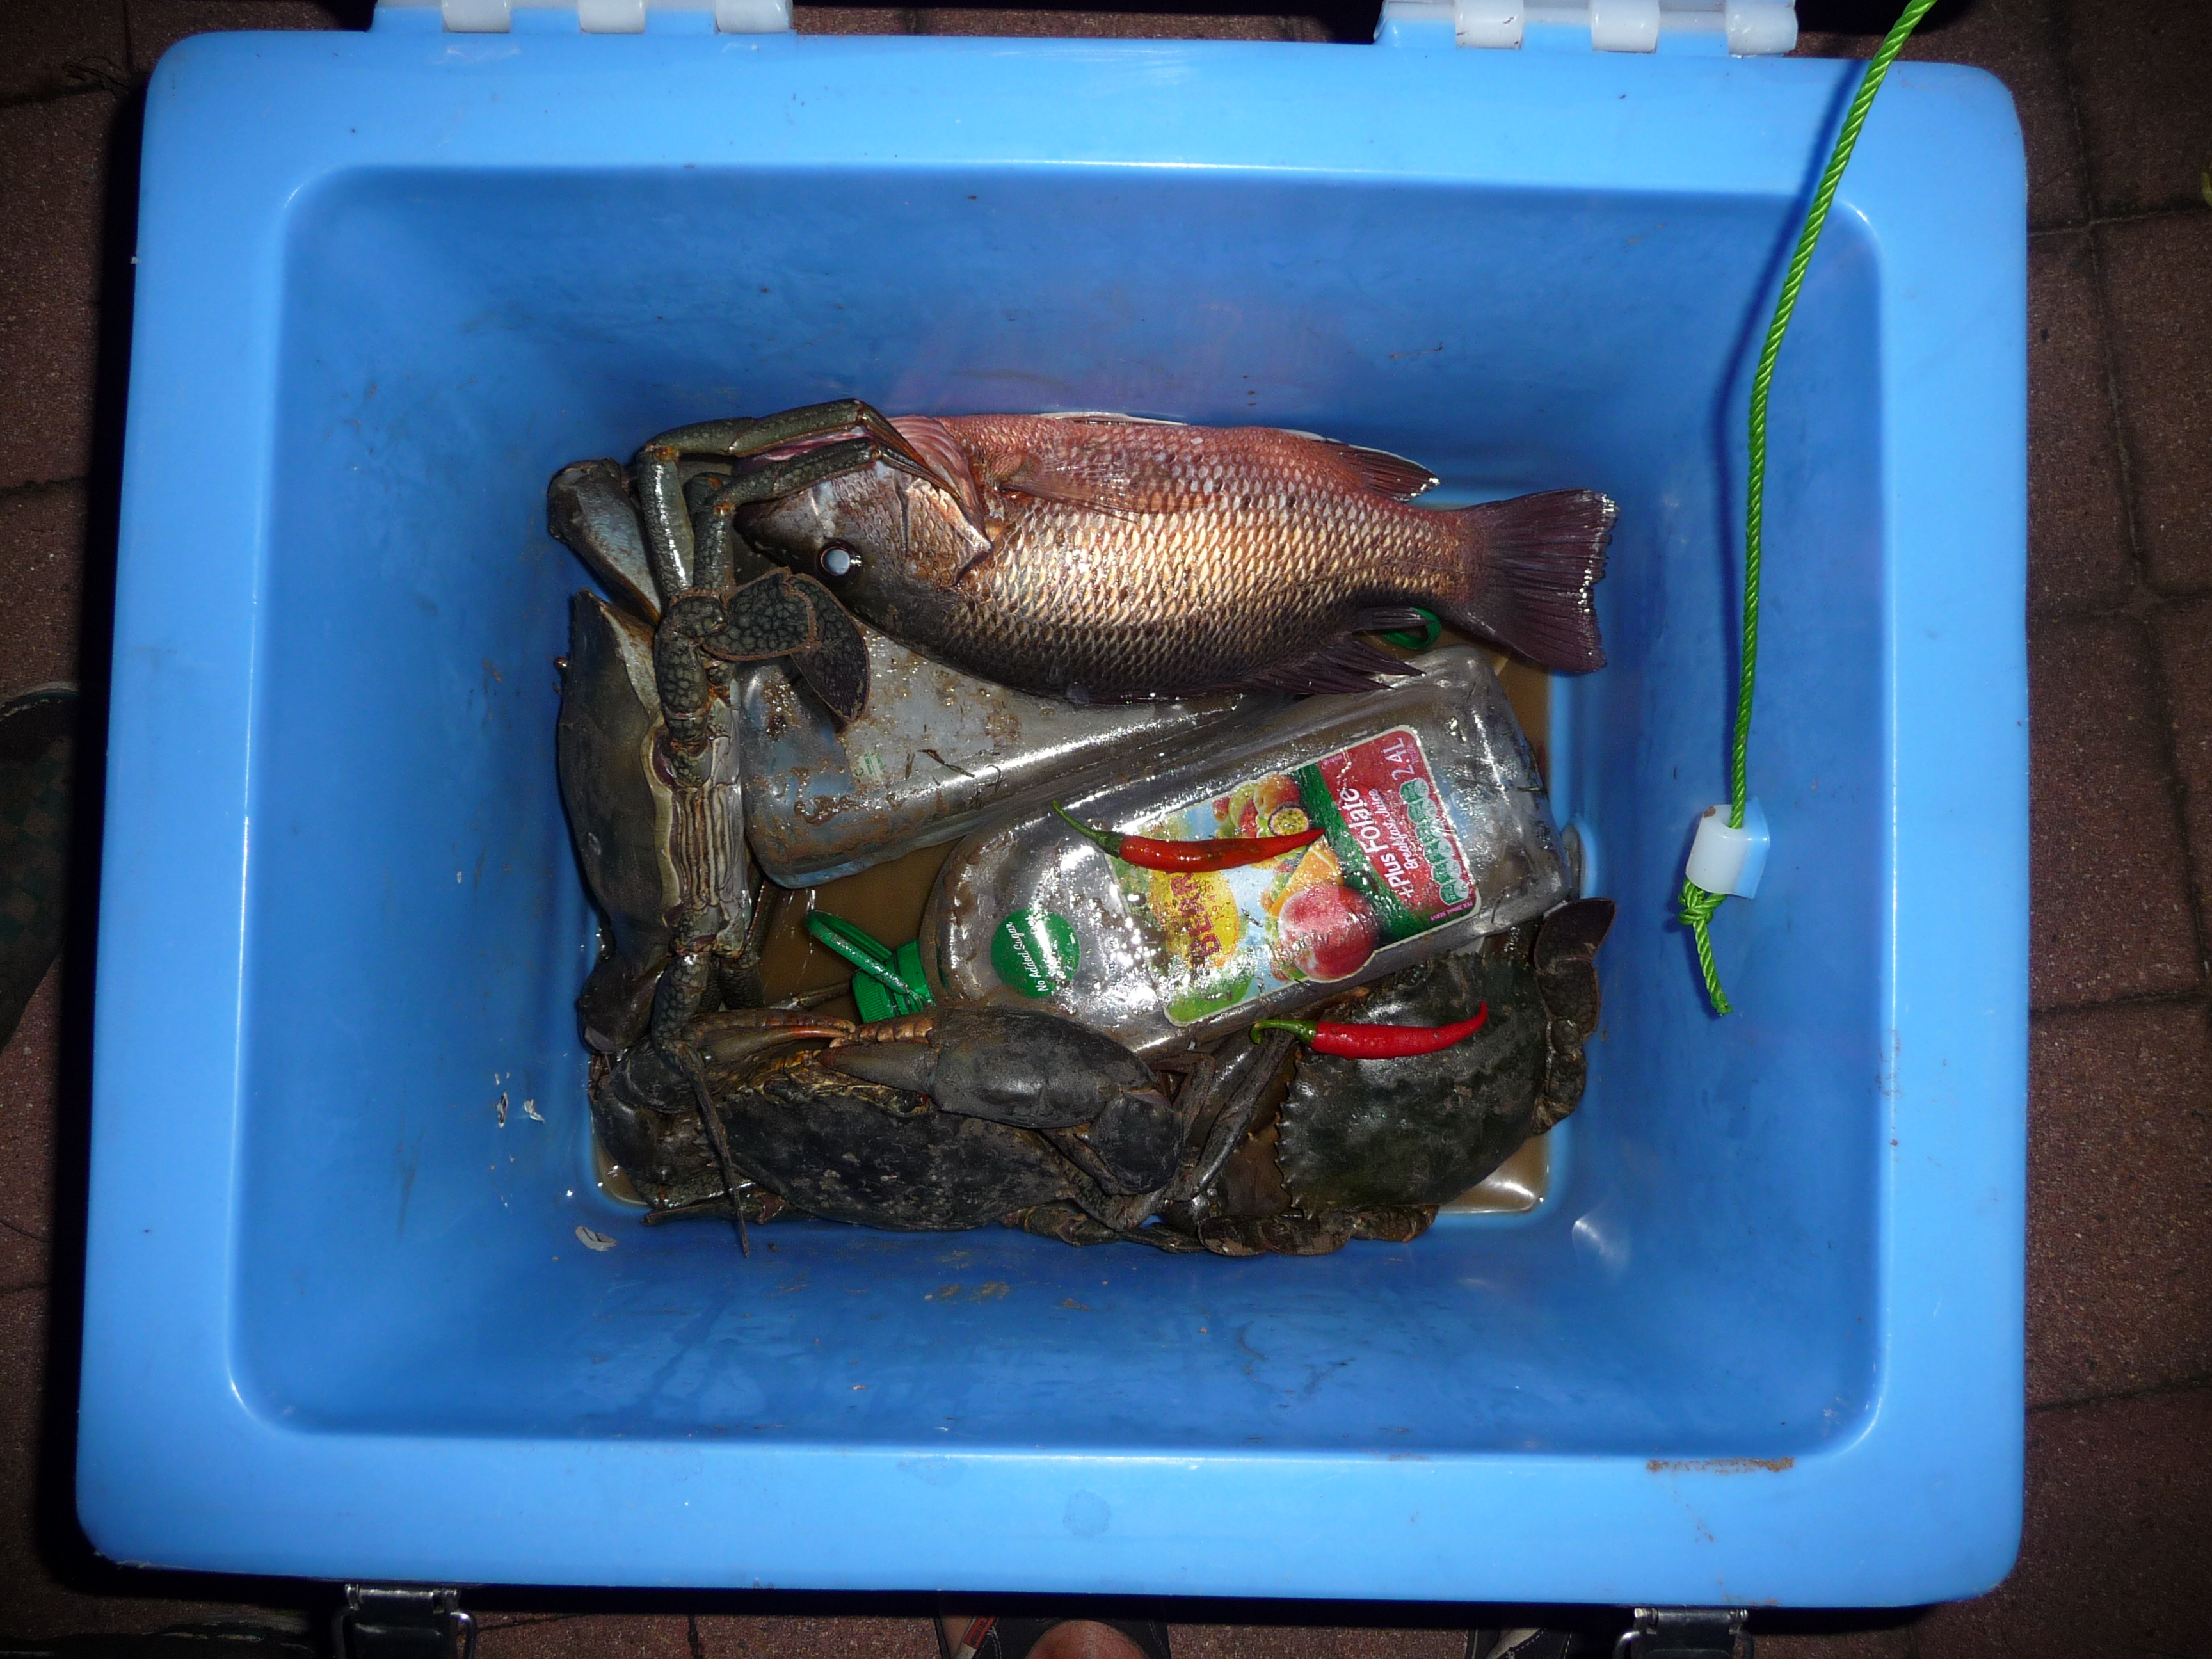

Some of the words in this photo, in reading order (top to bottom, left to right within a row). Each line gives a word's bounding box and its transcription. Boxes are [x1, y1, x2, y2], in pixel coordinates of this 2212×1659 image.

[1383, 737, 1415, 780] 2.4L
[1340, 788, 1389, 854] Folate
[1369, 789, 1390, 818] Juice
[1382, 819, 1418, 870] Breakfast
[1166, 872, 1222, 958] BERR
[1006, 922, 1025, 950] Sugar
[1017, 950, 1041, 978] Added
[1035, 980, 1049, 991] No
